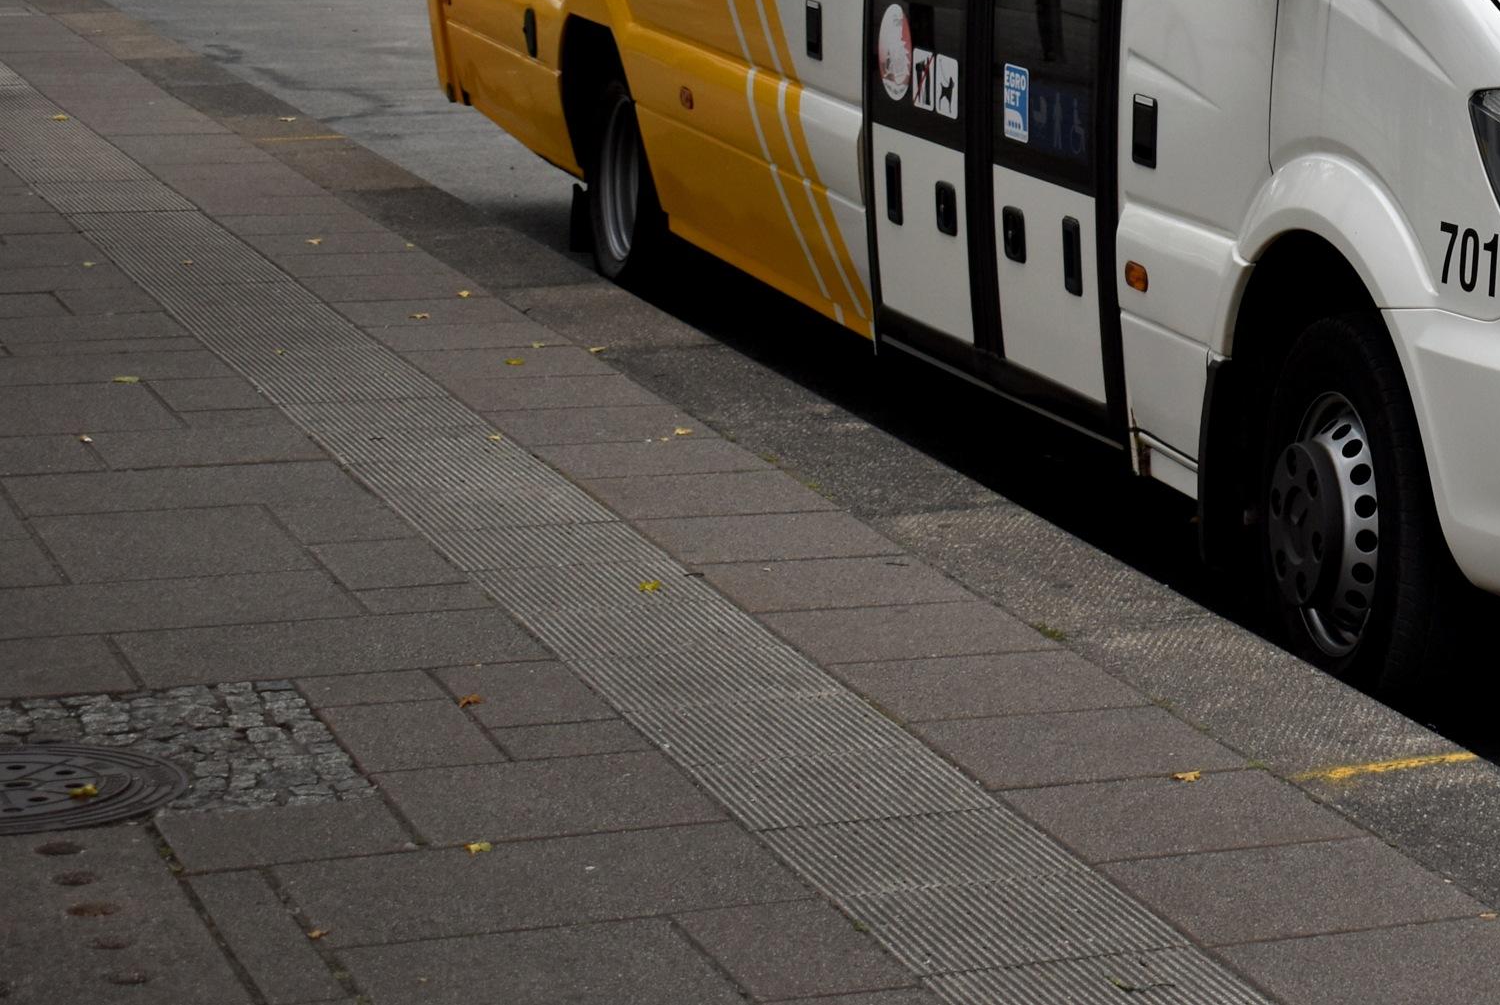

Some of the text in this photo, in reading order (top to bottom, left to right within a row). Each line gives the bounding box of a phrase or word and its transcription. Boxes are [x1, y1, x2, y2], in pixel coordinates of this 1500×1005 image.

[1005, 70, 1027, 91] EGRO
[1004, 89, 1021, 107] NET
[1440, 221, 1499, 297] 701
